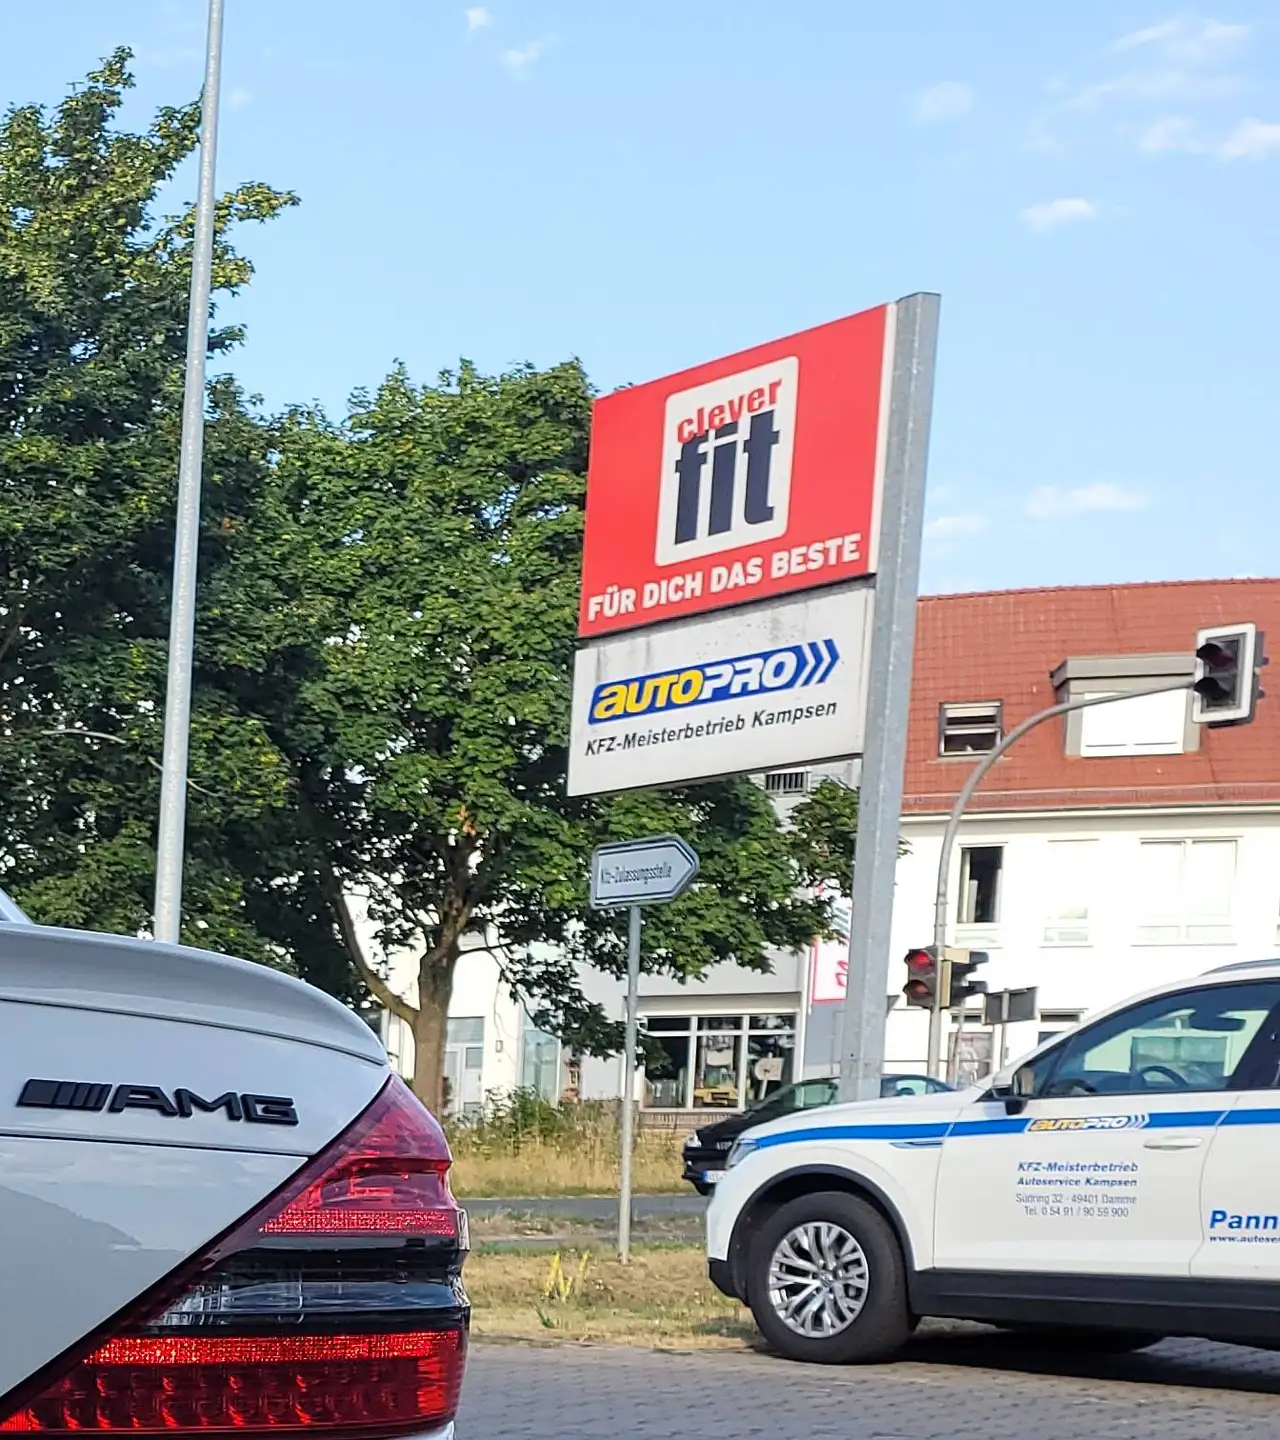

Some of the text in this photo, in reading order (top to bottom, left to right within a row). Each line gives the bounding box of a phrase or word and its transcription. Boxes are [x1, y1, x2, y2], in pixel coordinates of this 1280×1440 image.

[677, 379, 782, 443] clever
[674, 409, 781, 545] fit
[587, 533, 862, 622] FÜR DICH DAS BESTE
[584, 701, 839, 757] KFZ-Meisterbetrieb Kampsen
[107, 1083, 300, 1127] AMG
[1017, 1161, 1139, 1173] KFZ-Meisterbetrieb
[1017, 1177, 1138, 1188] Autoservice Kampsen
[1071, 1194, 1099, 1204] 49401
[1102, 1195, 1138, 1205] Damme
